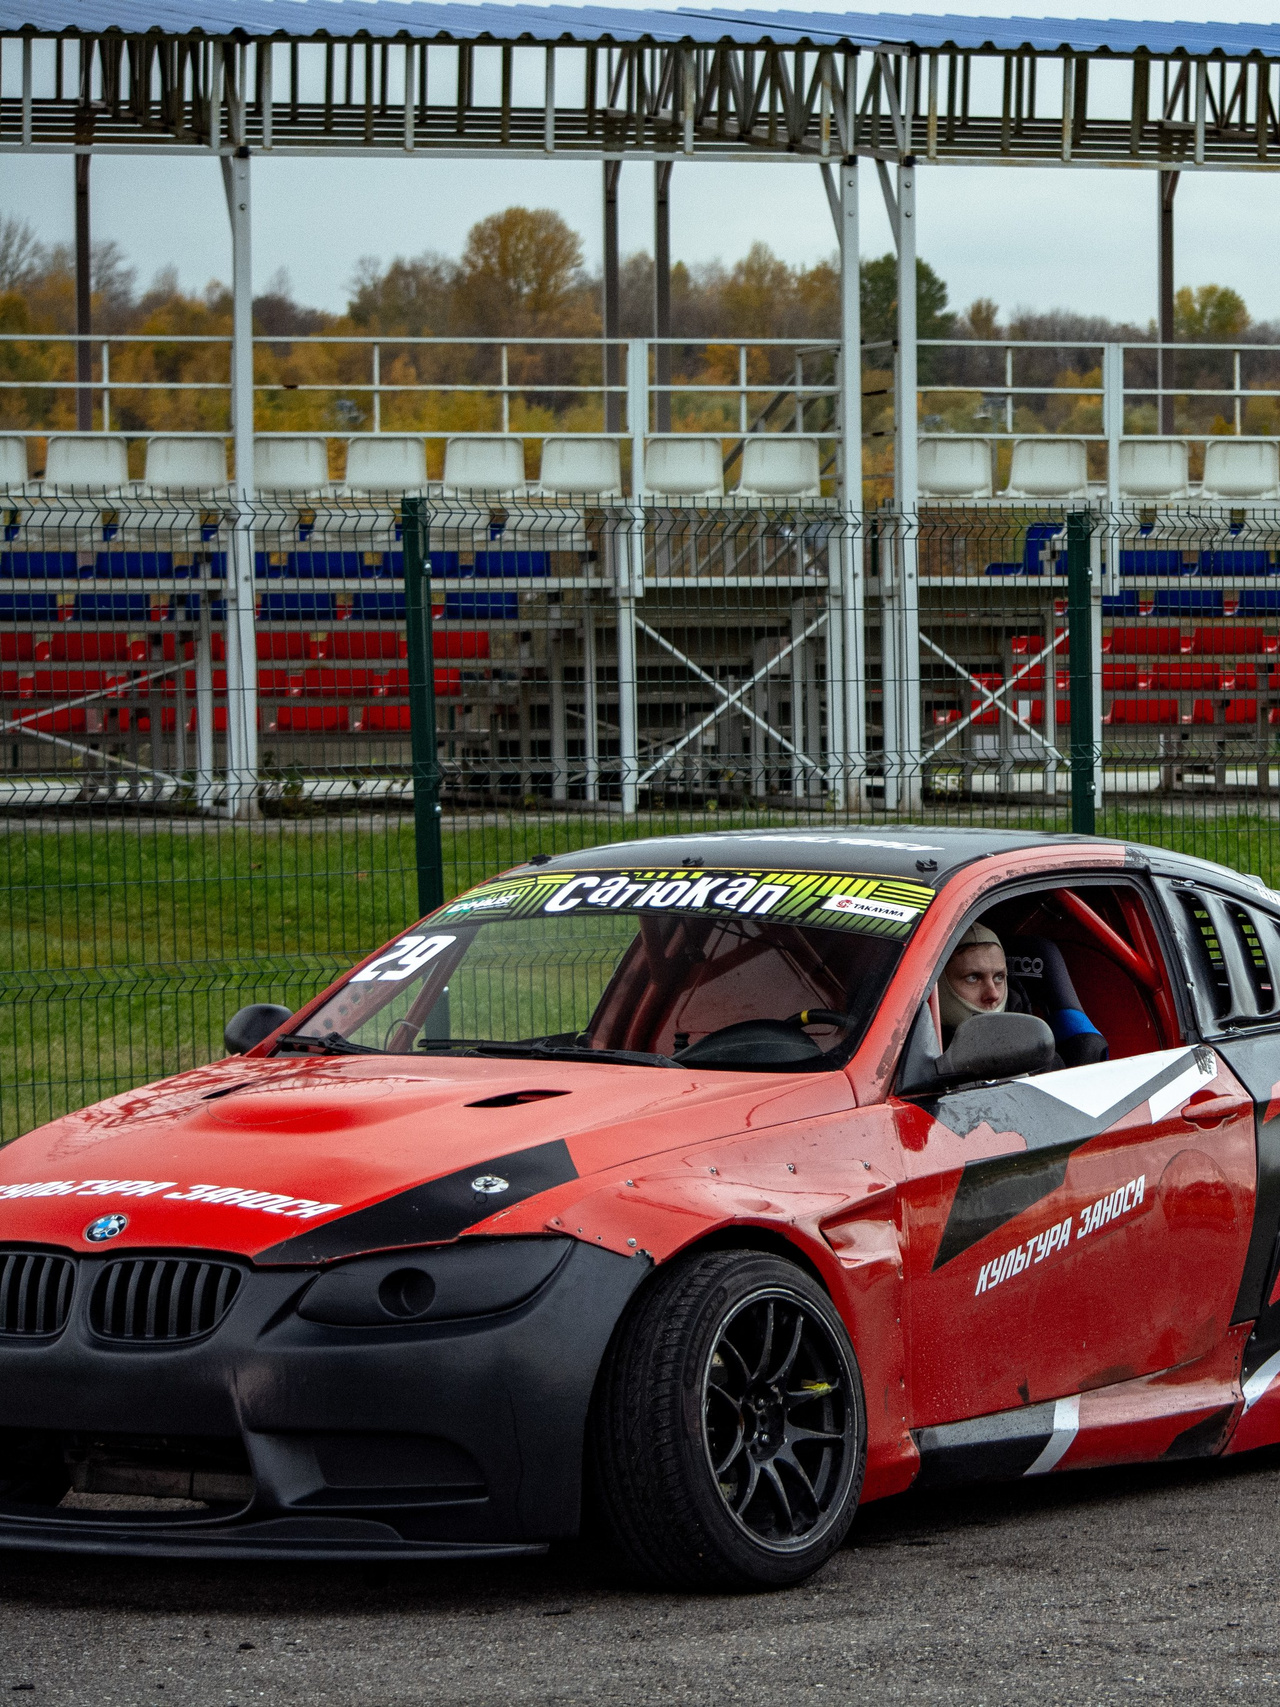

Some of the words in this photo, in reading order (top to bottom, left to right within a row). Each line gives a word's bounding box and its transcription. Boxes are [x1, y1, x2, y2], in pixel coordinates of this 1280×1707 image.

[853, 902, 905, 918] TAKAYAMA
[349, 935, 457, 982] 29
[0, 1180, 178, 1200] УЛЬТУРА
[163, 1184, 343, 1219] ЗАНОСА
[975, 1216, 1073, 1297] КУЛЬТУРА
[1076, 1173, 1146, 1240] ЗАНОСА
